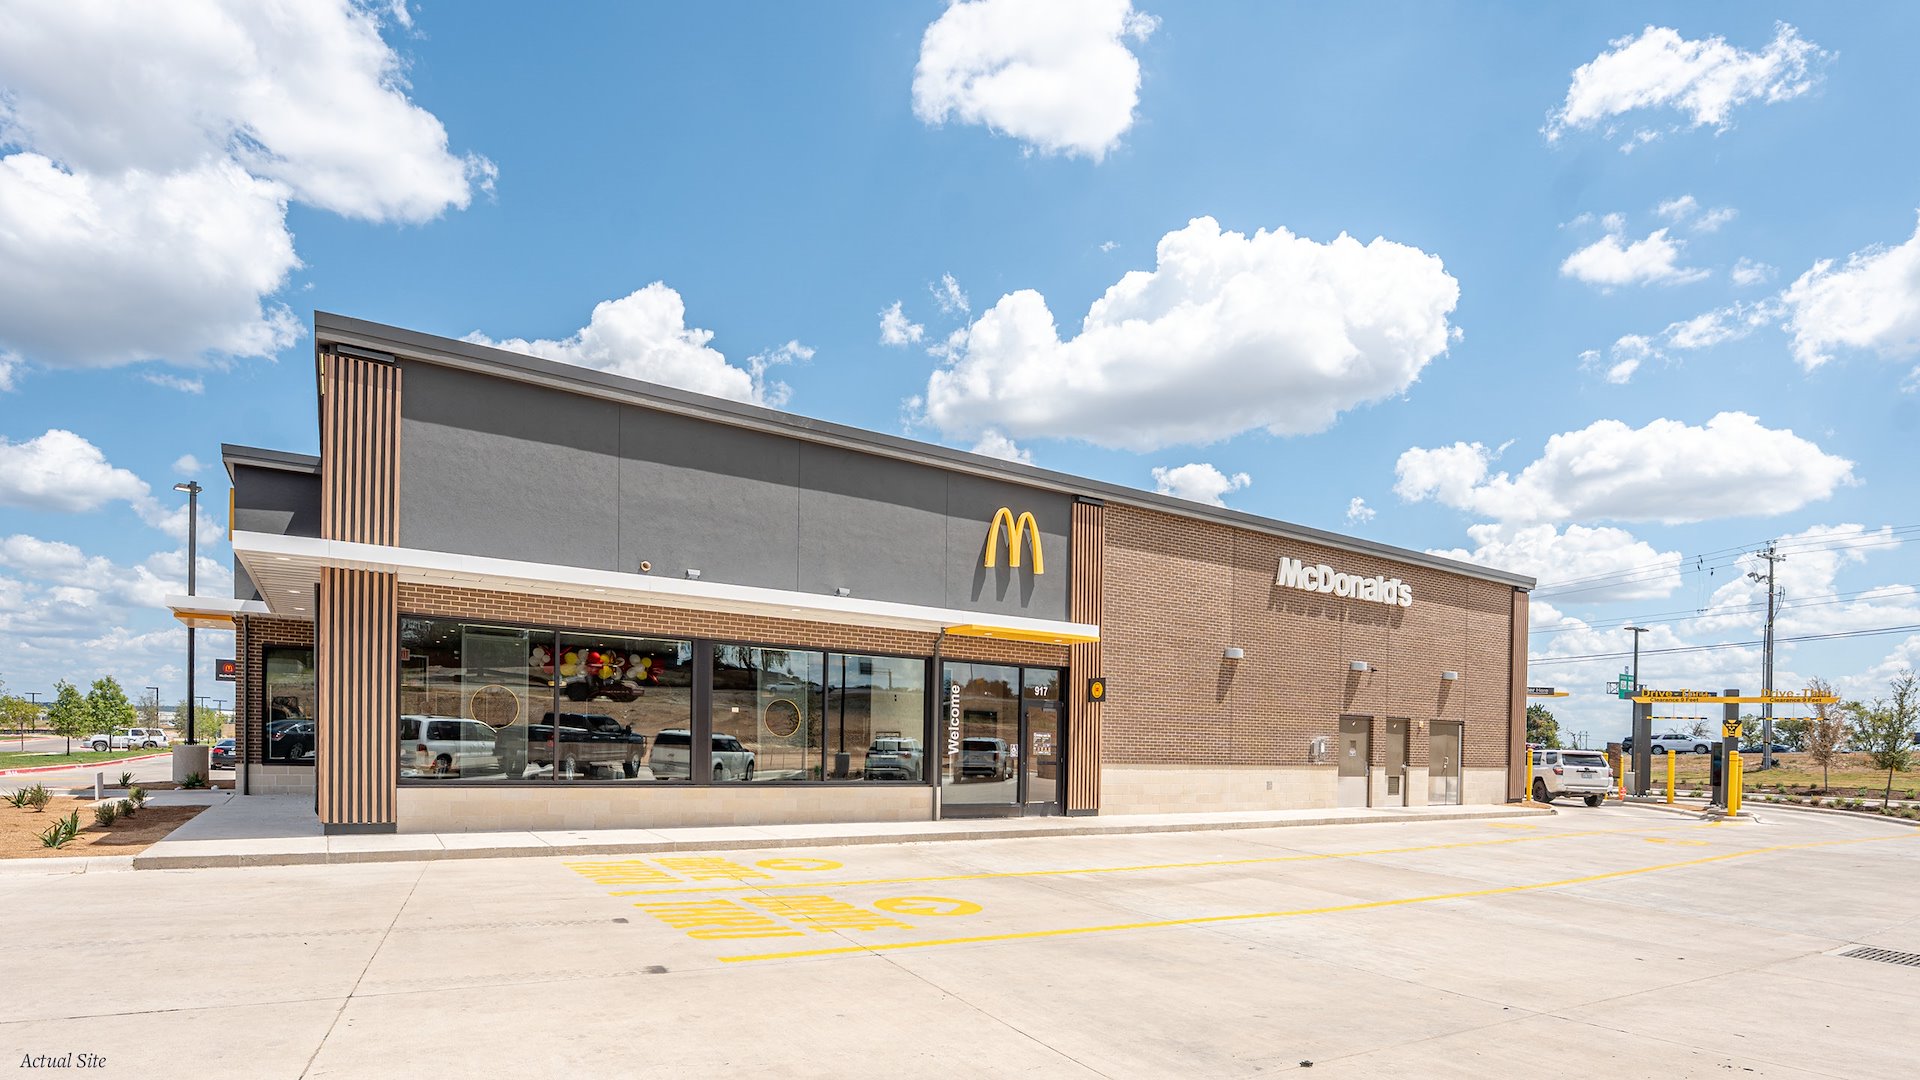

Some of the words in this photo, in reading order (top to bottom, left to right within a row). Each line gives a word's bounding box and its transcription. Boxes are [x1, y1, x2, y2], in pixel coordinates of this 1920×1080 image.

[1275, 556, 1413, 607] McDonald's
[1034, 686, 1049, 696] 917
[947, 684, 961, 755] Welcome
[562, 859, 685, 885] THRU
[632, 898, 807, 940] THRU
[740, 895, 918, 932] DRIVE
